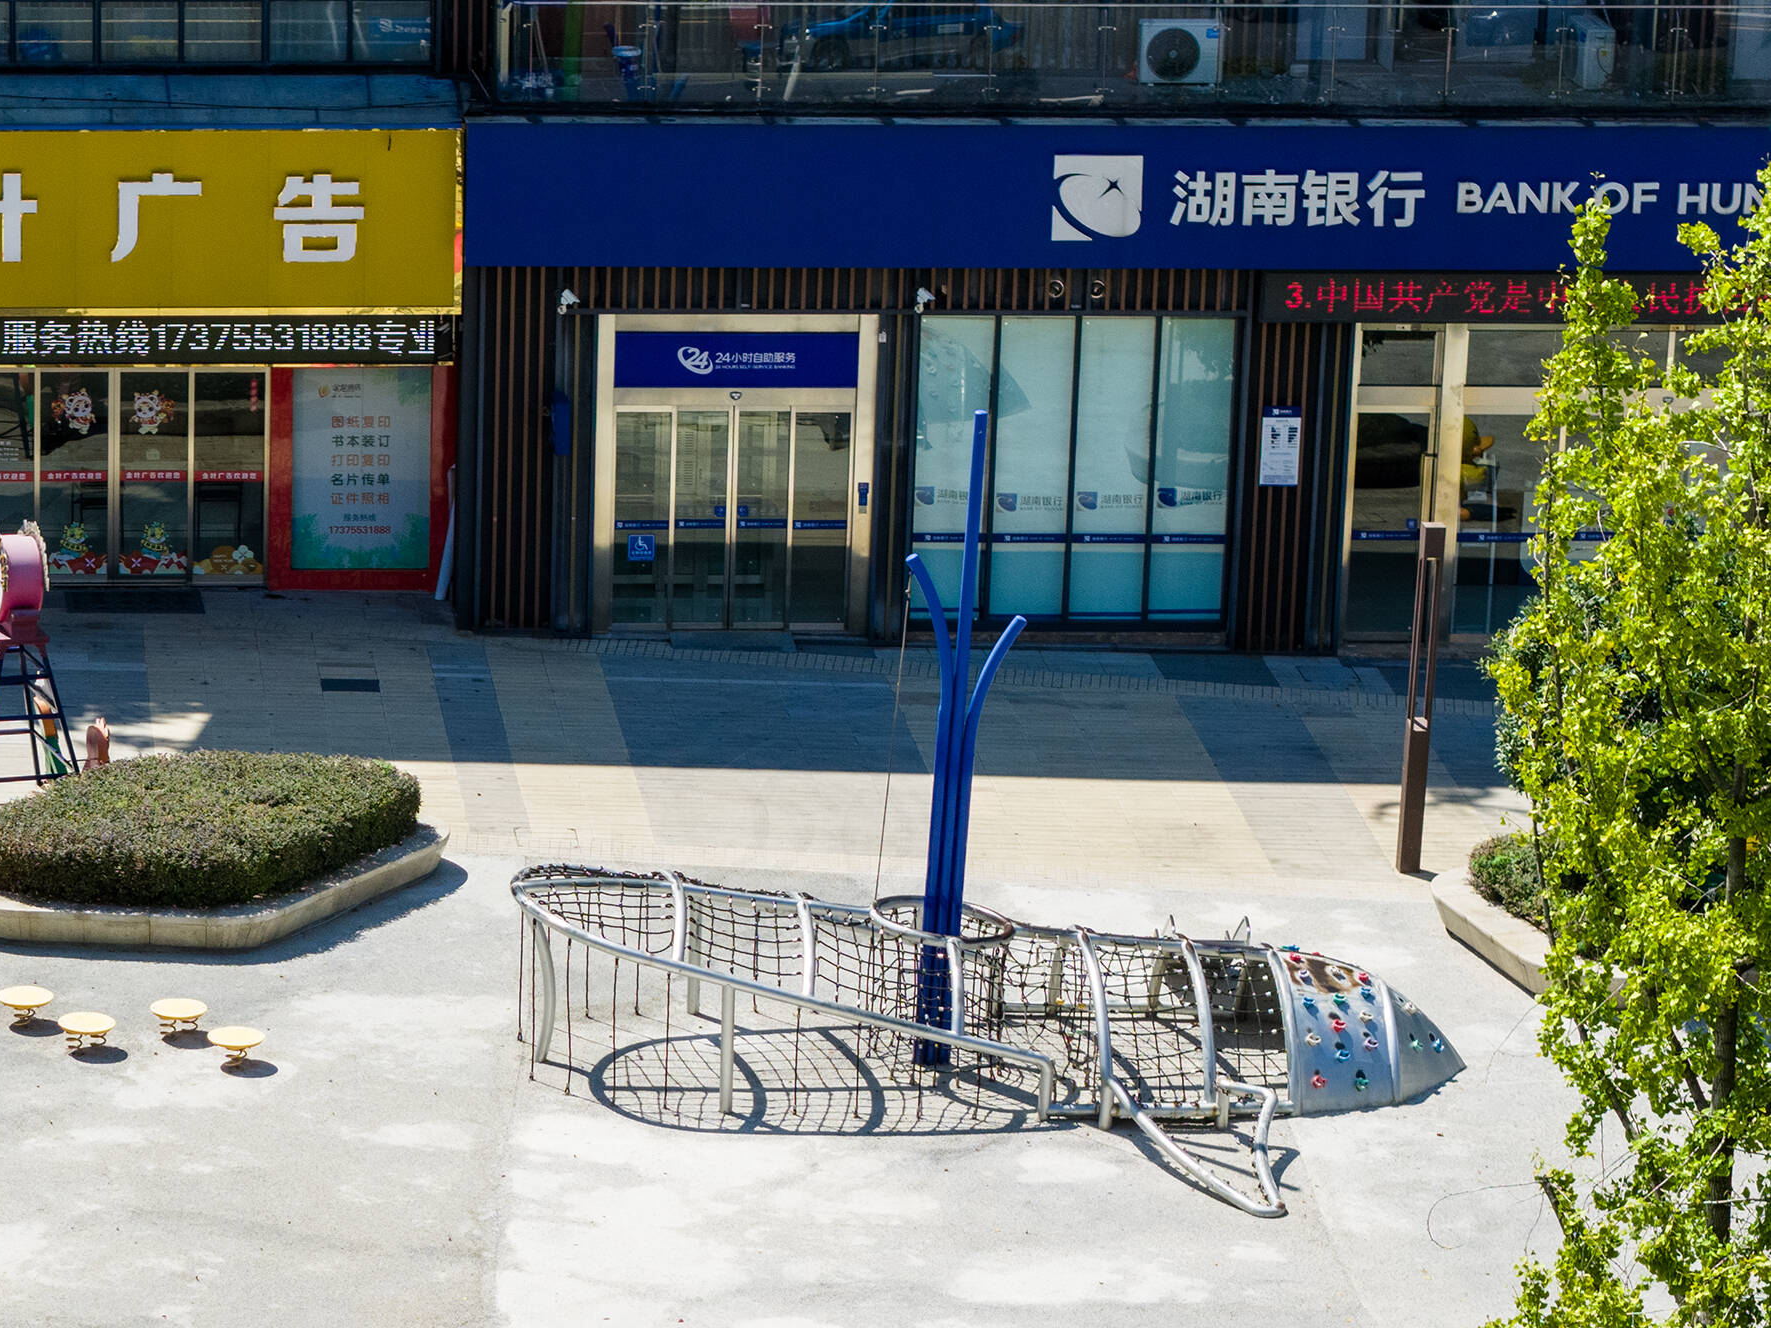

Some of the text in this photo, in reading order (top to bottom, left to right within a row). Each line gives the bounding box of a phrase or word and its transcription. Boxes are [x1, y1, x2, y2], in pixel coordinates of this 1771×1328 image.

[1169, 169, 1425, 227] 湖南银行
[1456, 182, 1580, 214] BANK
[1593, 182, 1660, 214] OF
[715, 352, 796, 364] 24小时自助服务
[331, 416, 391, 428] 图纸复印
[331, 435, 391, 448] 书本装订
[331, 454, 390, 467] 打印复印
[331, 473, 390, 486] 名片传单
[331, 492, 390, 505] 证件照相
[937, 489, 969, 500] 湖南银
[328, 526, 391, 534] 17375531888
